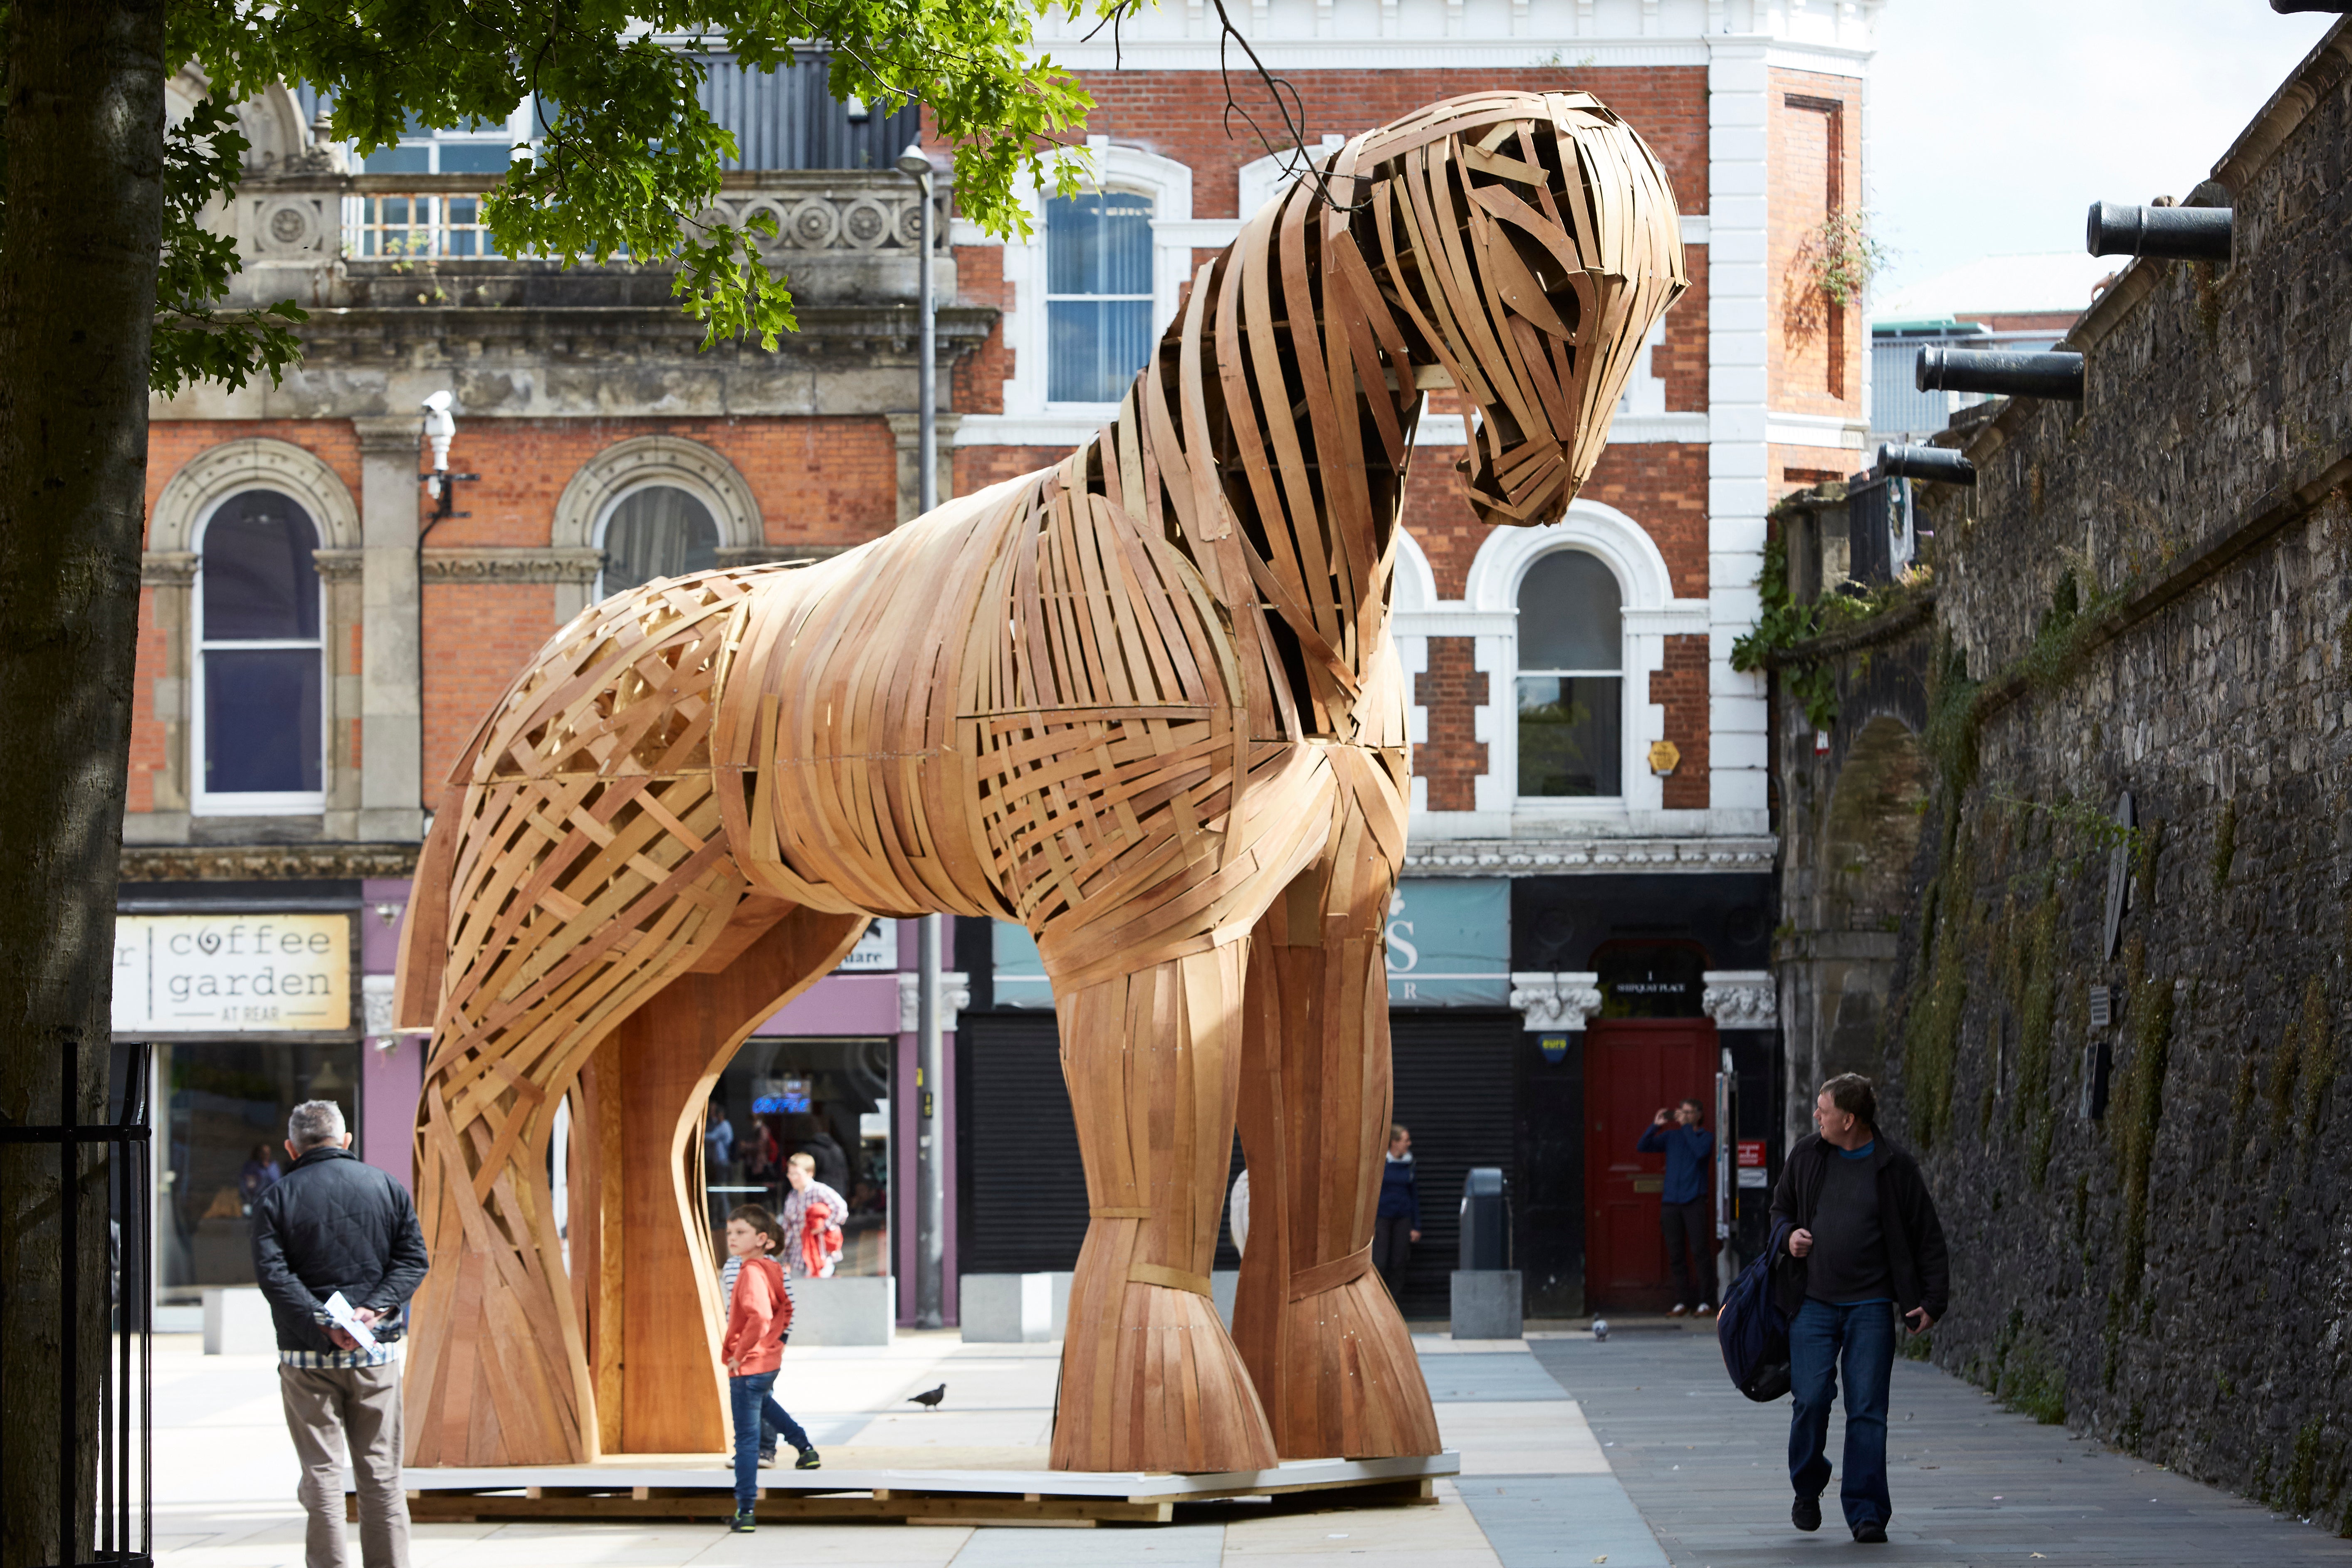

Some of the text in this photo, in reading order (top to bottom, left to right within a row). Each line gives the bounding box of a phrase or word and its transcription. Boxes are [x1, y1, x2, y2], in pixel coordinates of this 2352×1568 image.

[170, 925, 330, 955] coffee
[842, 952, 882, 964] uare
[169, 966, 331, 1002] garden
[222, 1006, 279, 1020] AT REAR
